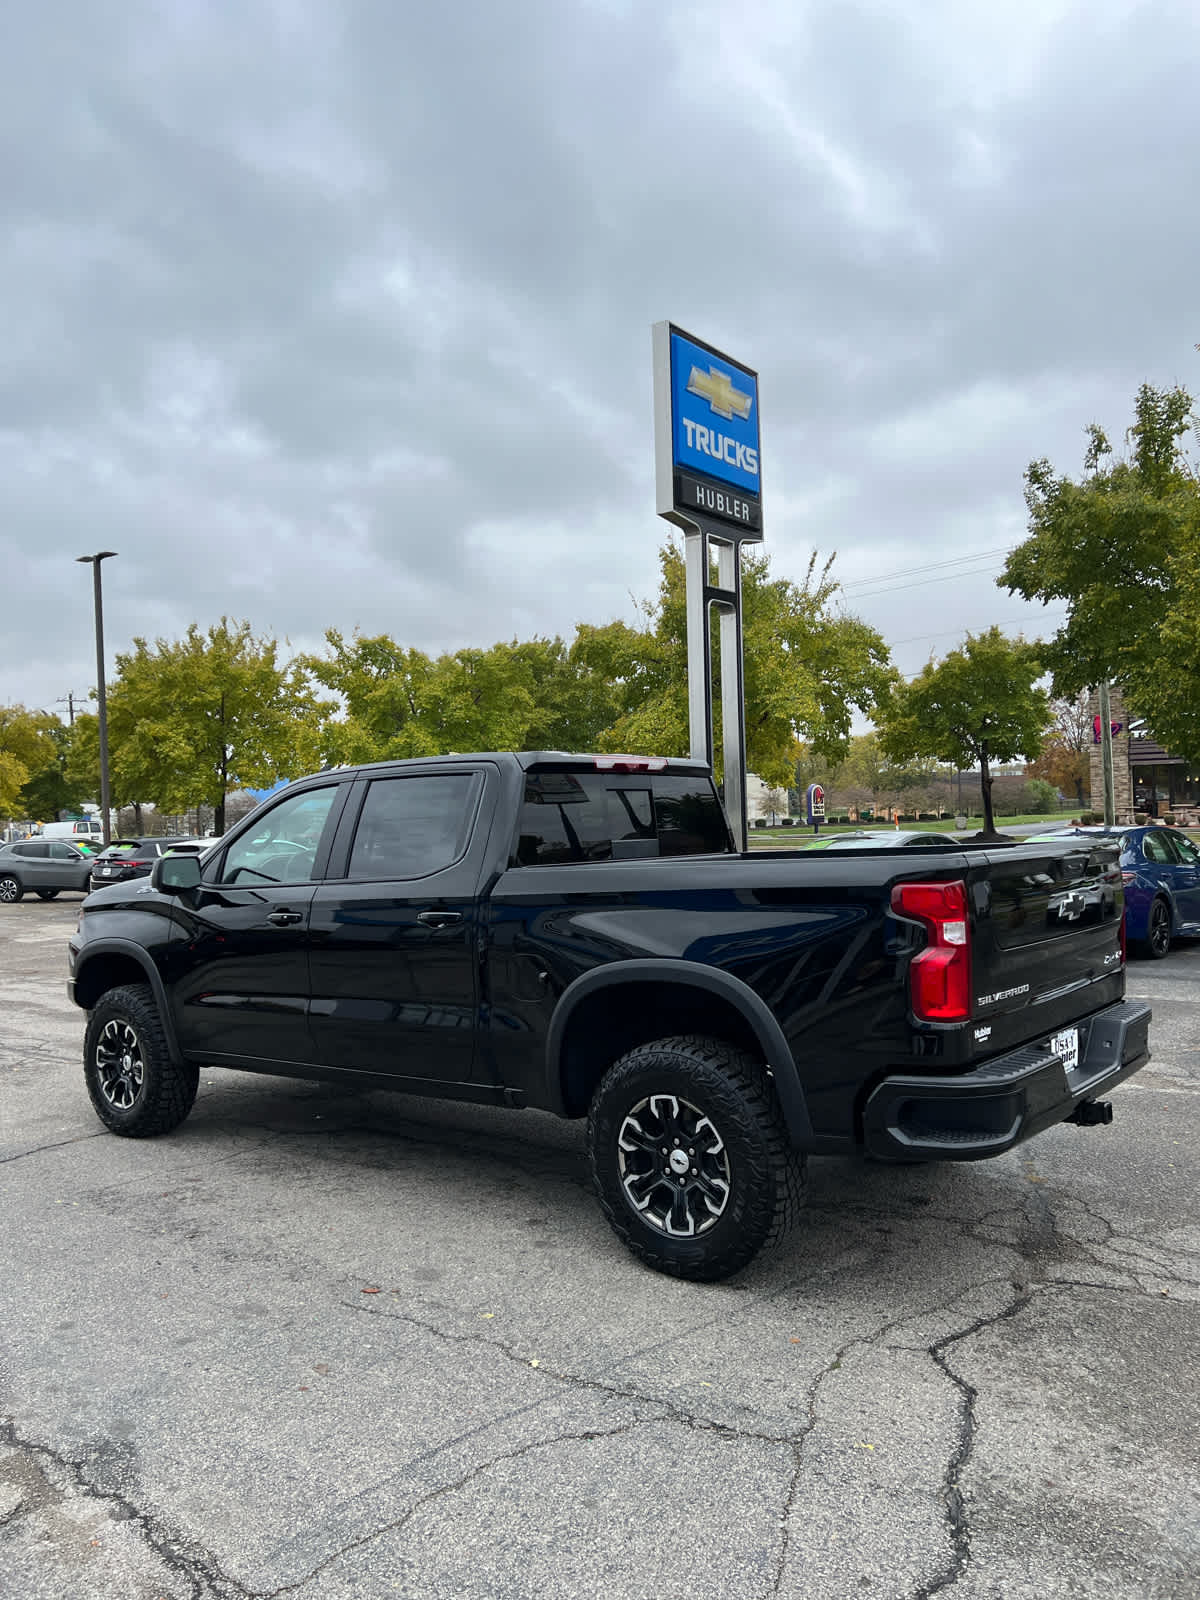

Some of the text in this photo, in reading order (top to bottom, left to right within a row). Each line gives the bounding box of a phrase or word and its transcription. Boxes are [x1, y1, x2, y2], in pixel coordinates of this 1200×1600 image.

[682, 416, 758, 475] TRUCKS
[696, 485, 750, 521] HUBLER
[977, 983, 1030, 1006] SILVERADO
